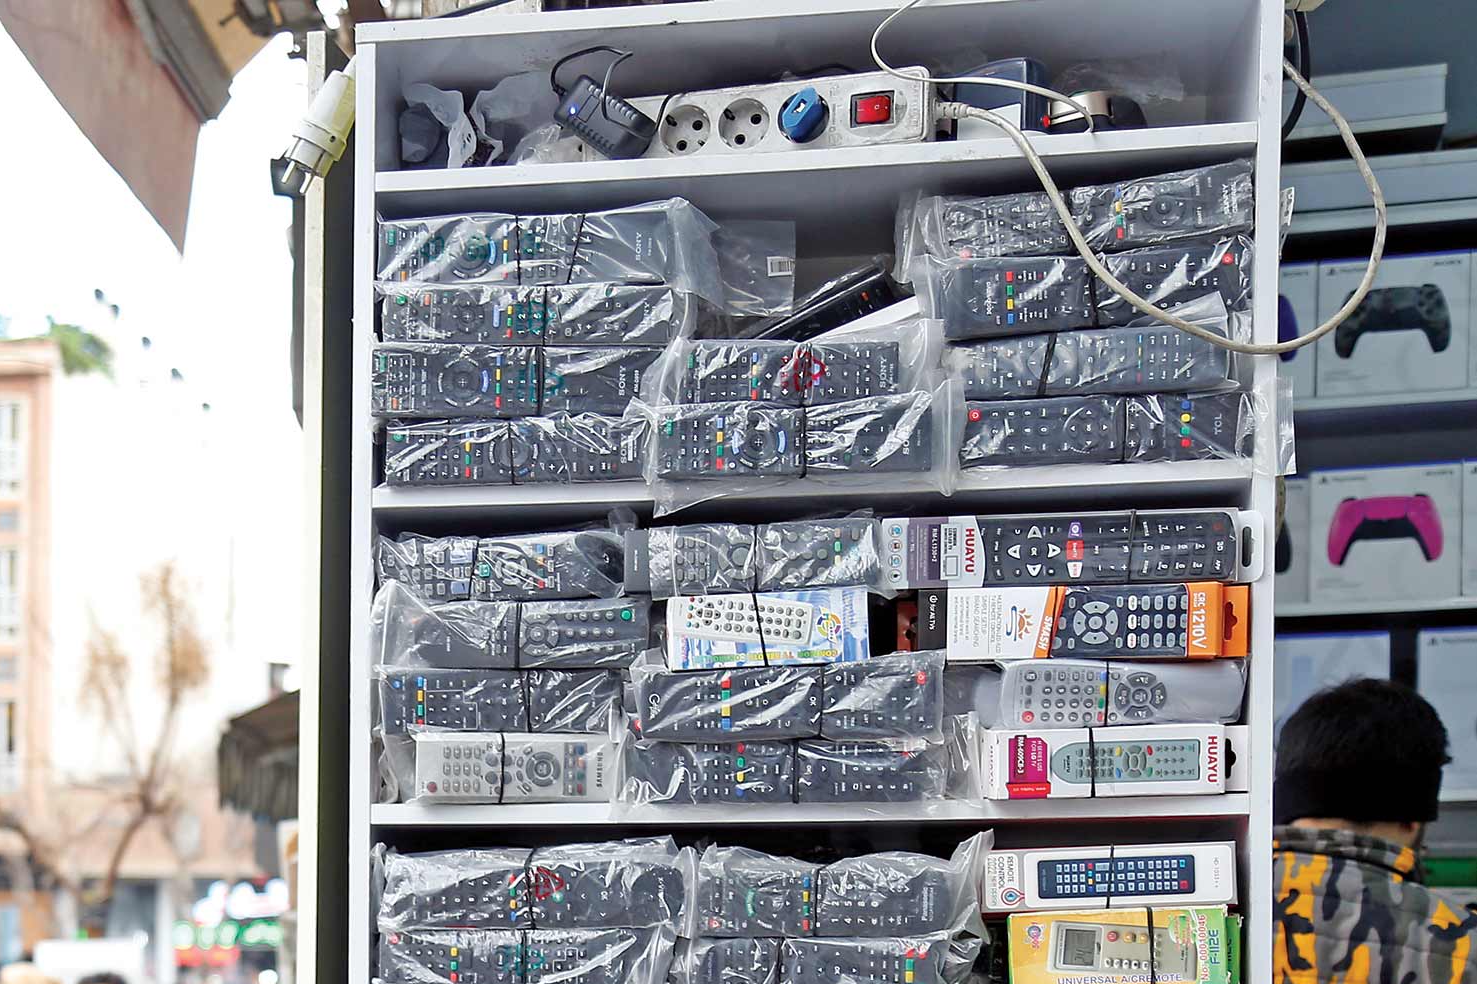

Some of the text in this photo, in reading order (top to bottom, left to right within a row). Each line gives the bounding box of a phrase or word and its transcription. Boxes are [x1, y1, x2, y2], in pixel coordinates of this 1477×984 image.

[1214, 413, 1222, 435] TCL
[965, 528, 975, 572] HUAYU
[1037, 616, 1053, 650] SMASH
[1192, 592, 1207, 648] CRC 1210V
[1208, 736, 1217, 782] HUAYU
